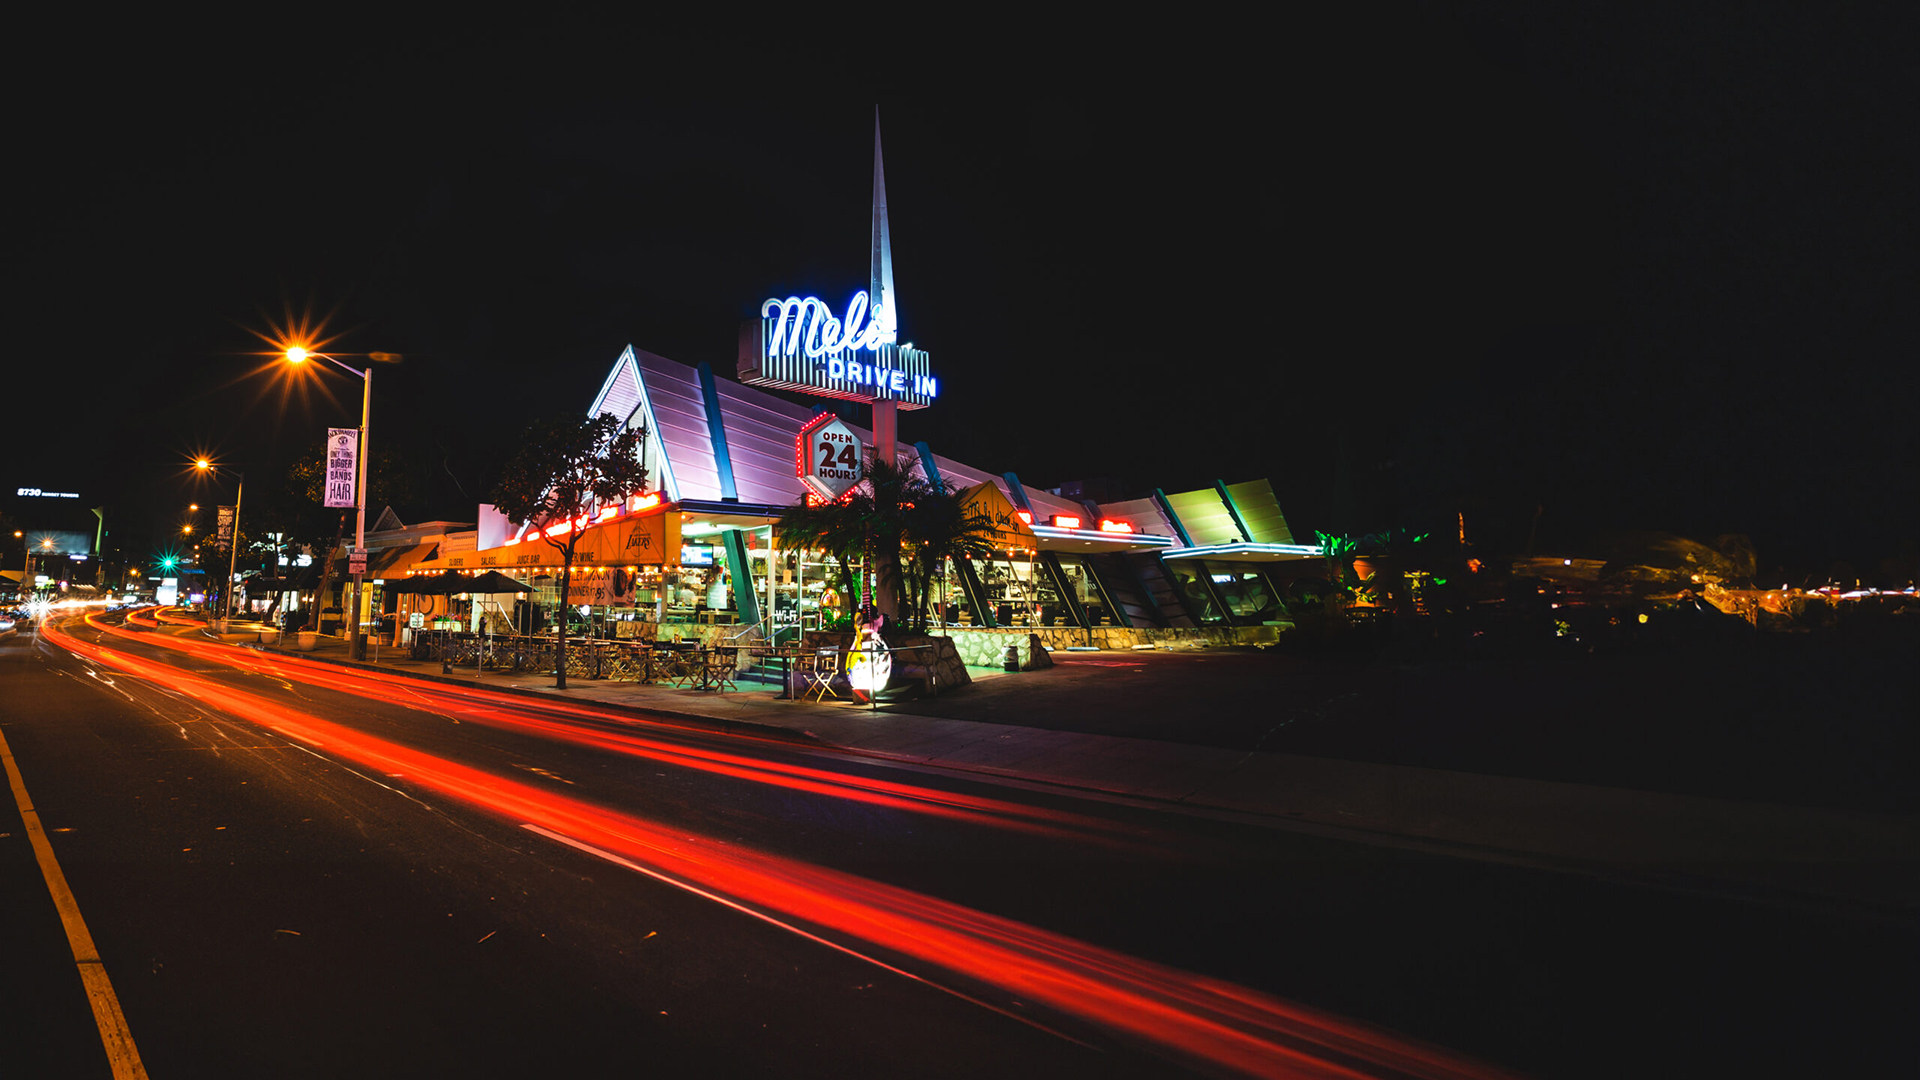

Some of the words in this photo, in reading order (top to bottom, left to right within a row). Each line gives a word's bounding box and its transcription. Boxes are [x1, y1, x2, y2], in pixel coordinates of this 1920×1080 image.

[828, 357, 905, 391] DRIVE
[914, 374, 937, 397] IN
[823, 432, 853, 444] OPEN
[819, 442, 857, 470] 24
[330, 458, 353, 469] BIGGER
[330, 471, 352, 481] BANDS
[819, 468, 857, 480] HOURS
[17, 488, 41, 497] 8730
[329, 483, 351, 500] HAIR
[626, 534, 651, 550] LAKERS
[449, 558, 464, 567] SLIDERS
[481, 556, 497, 566] SALADS
[516, 556, 530, 565] JUICE
[531, 554, 540, 564] BAR
[775, 609, 797, 622] Wi-Fi
